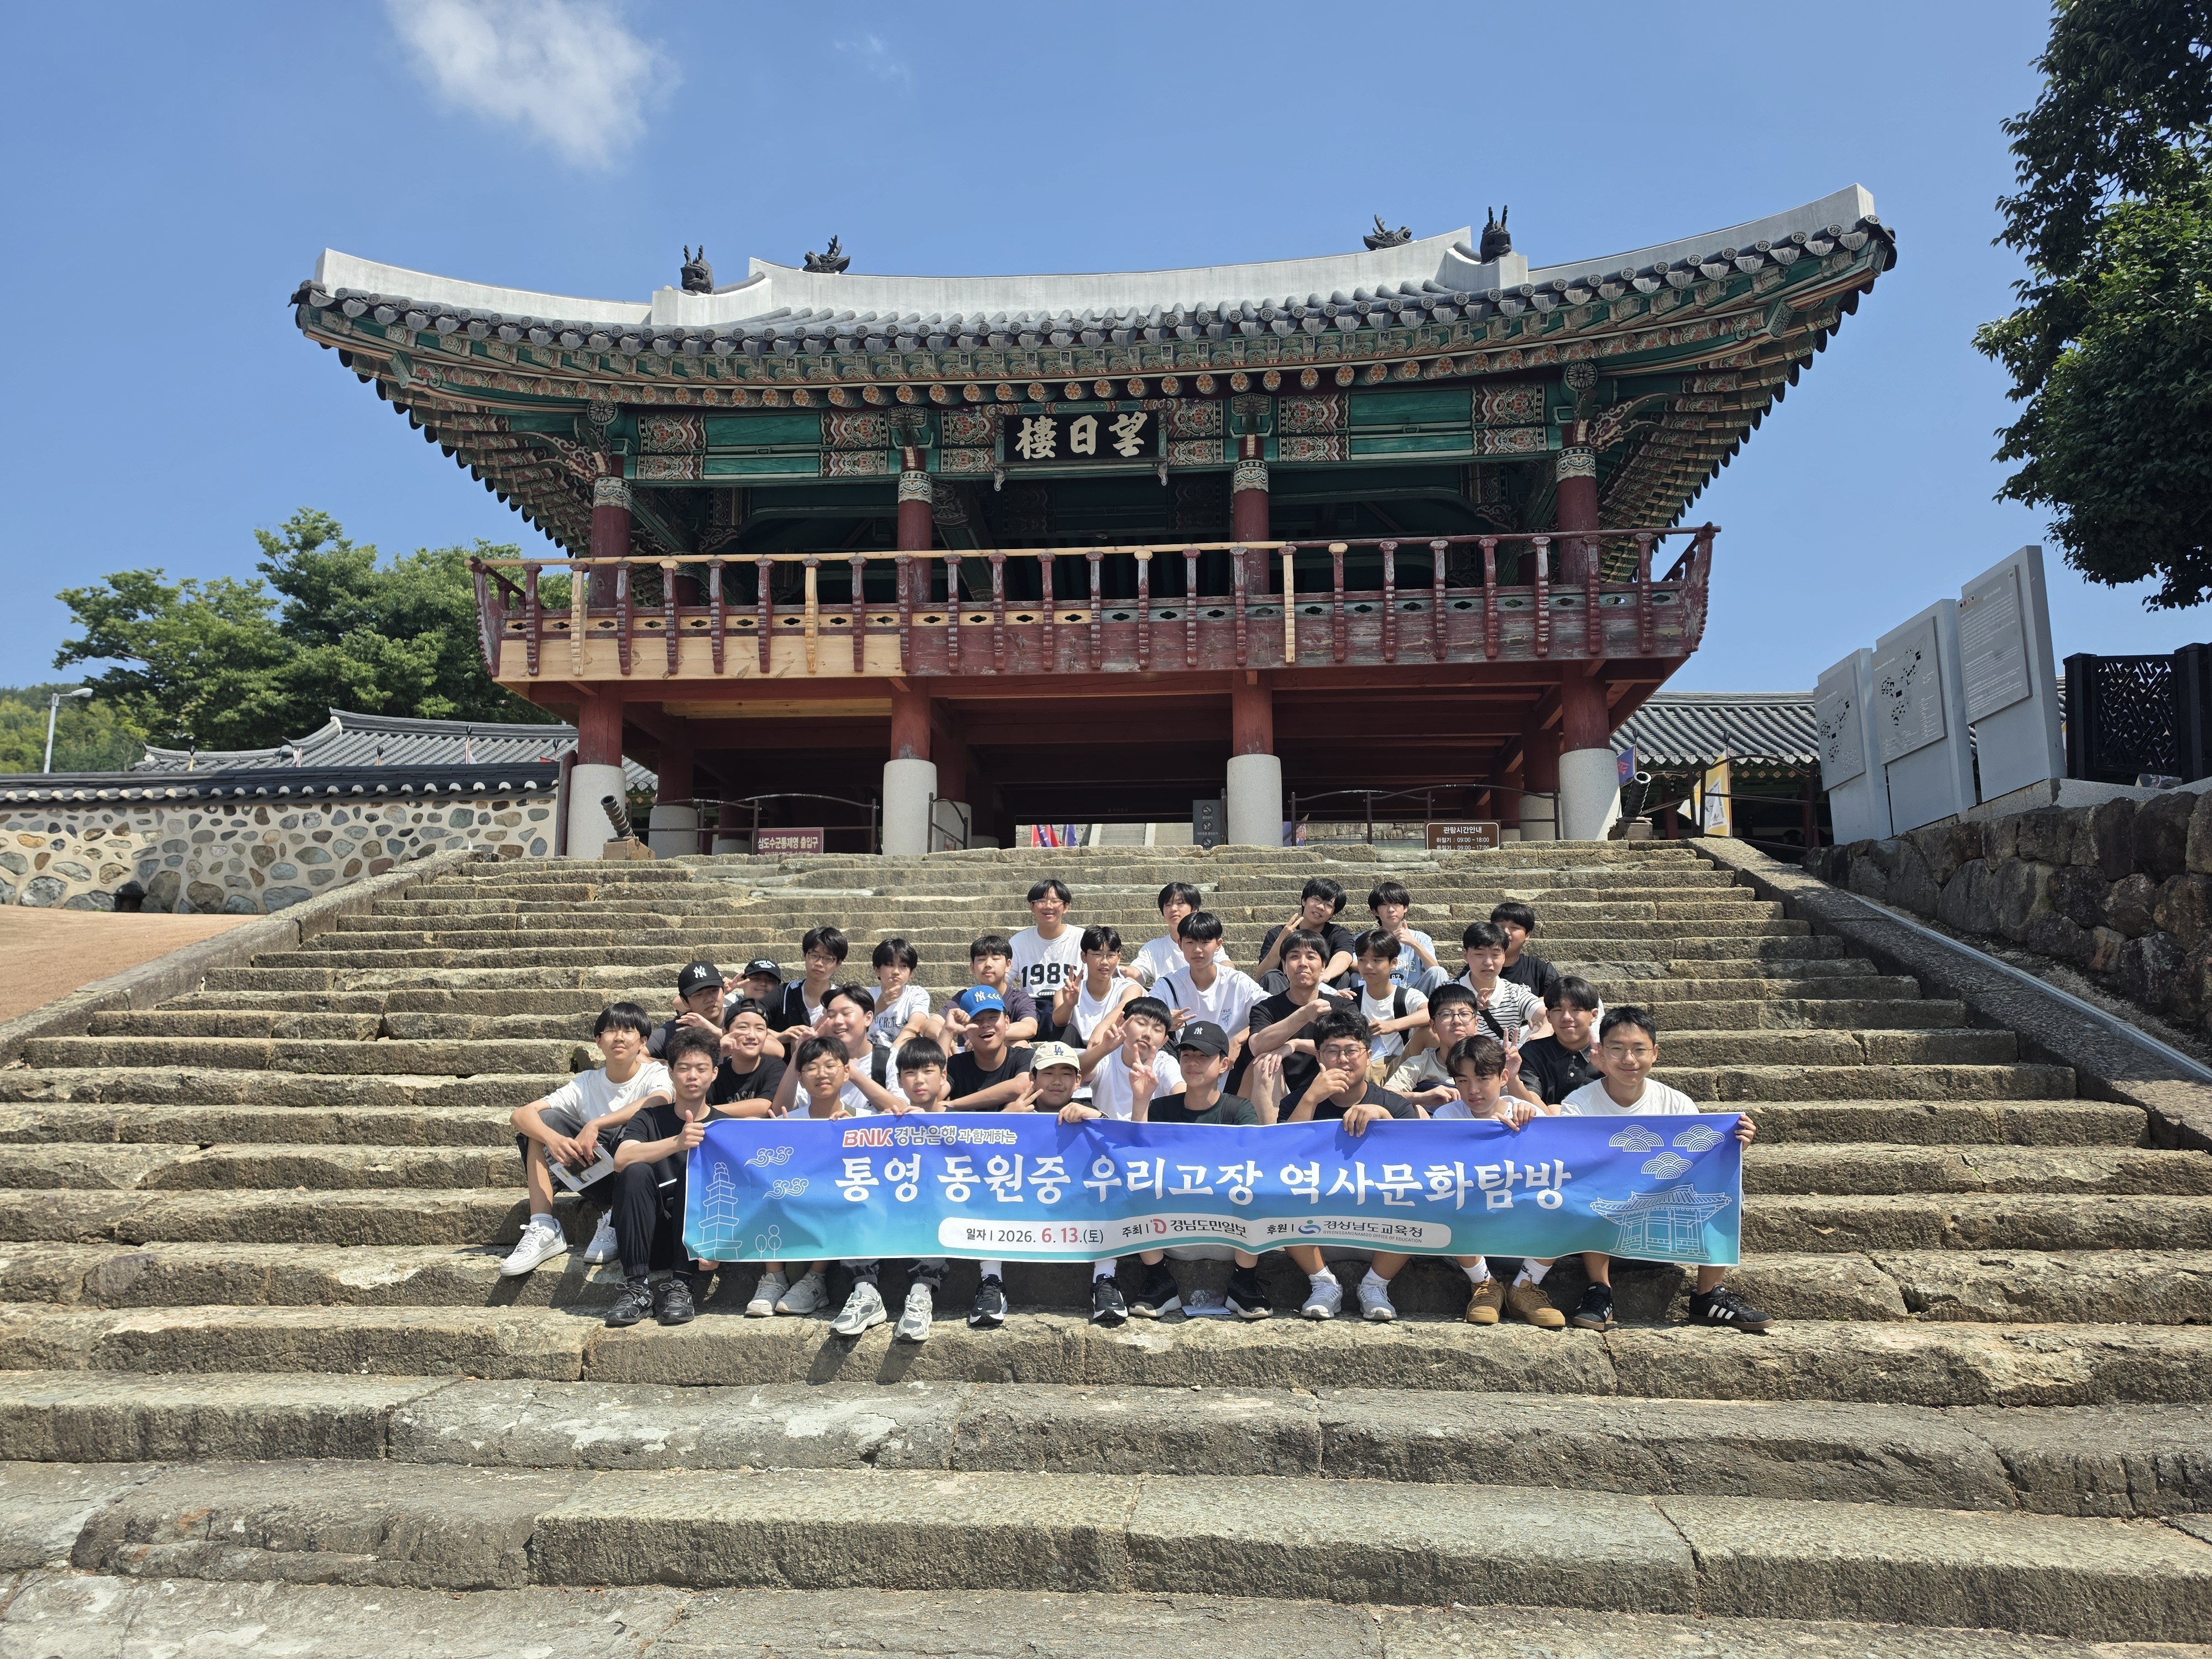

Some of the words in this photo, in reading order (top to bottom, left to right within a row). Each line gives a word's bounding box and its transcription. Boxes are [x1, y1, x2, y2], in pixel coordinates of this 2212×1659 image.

[758, 837, 799, 849] 삼도수군통제영
[800, 836, 818, 849] 출입구
[693, 966, 707, 978] NY
[1053, 1045, 1063, 1056] LA
[843, 1128, 893, 1147] BNK
[895, 1126, 957, 1146] 경남은행
[834, 1153, 921, 1202] 통영
[937, 1154, 1071, 1204] 동원중
[1083, 1155, 1263, 1205] 우리고장
[1280, 1159, 1572, 1210] 역사문화탐방
[966, 1228, 986, 1240] 일자
[998, 1230, 1036, 1243] 2026.
[1122, 1224, 1142, 1238] 주최
[1170, 1220, 1247, 1238] 경남도민일보
[1267, 1224, 1287, 1234] 후원
[1323, 1221, 1422, 1238] 경상남도교육청
